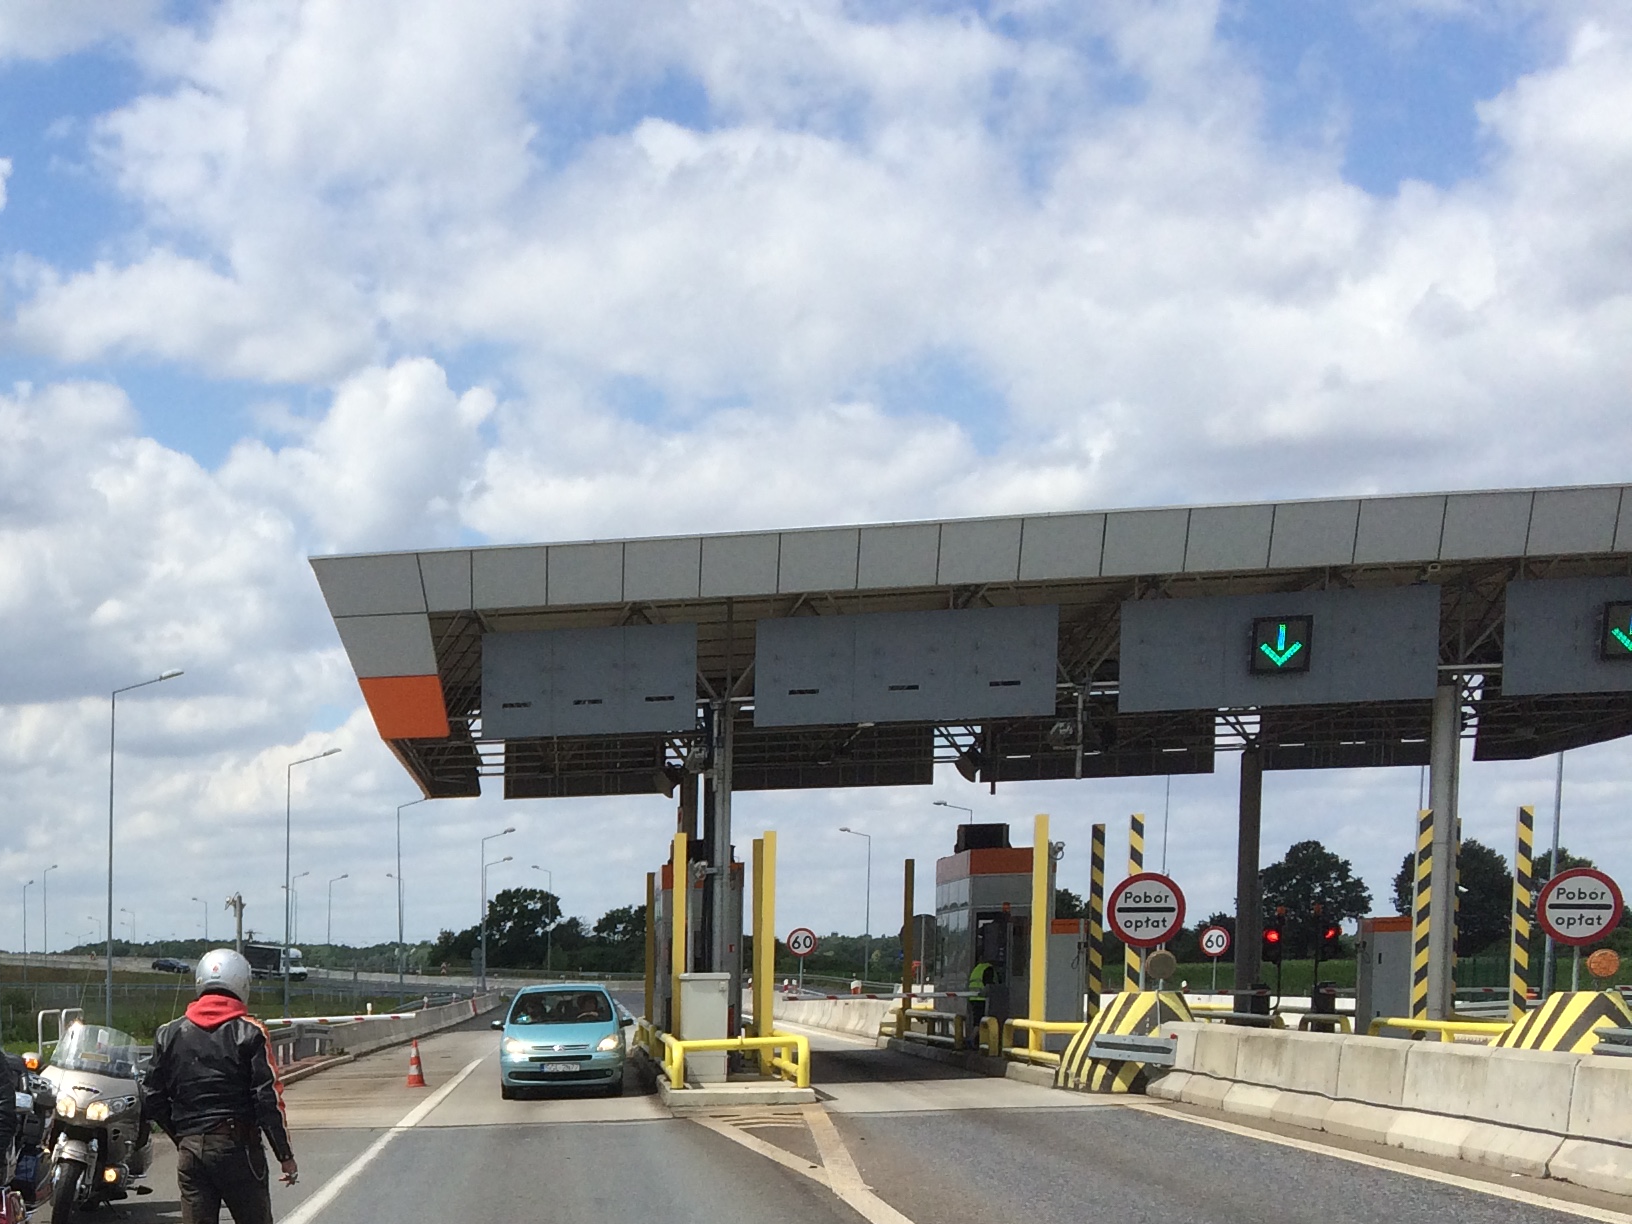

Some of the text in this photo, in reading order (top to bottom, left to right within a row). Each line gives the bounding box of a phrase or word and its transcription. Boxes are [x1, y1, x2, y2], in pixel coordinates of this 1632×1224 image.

[1124, 890, 1170, 904] Pobór
[1556, 887, 1606, 900] Pobór
[1124, 916, 1167, 932] opłat
[1555, 913, 1602, 929] opłat
[792, 935, 813, 950] 60
[1205, 934, 1225, 948] 60
